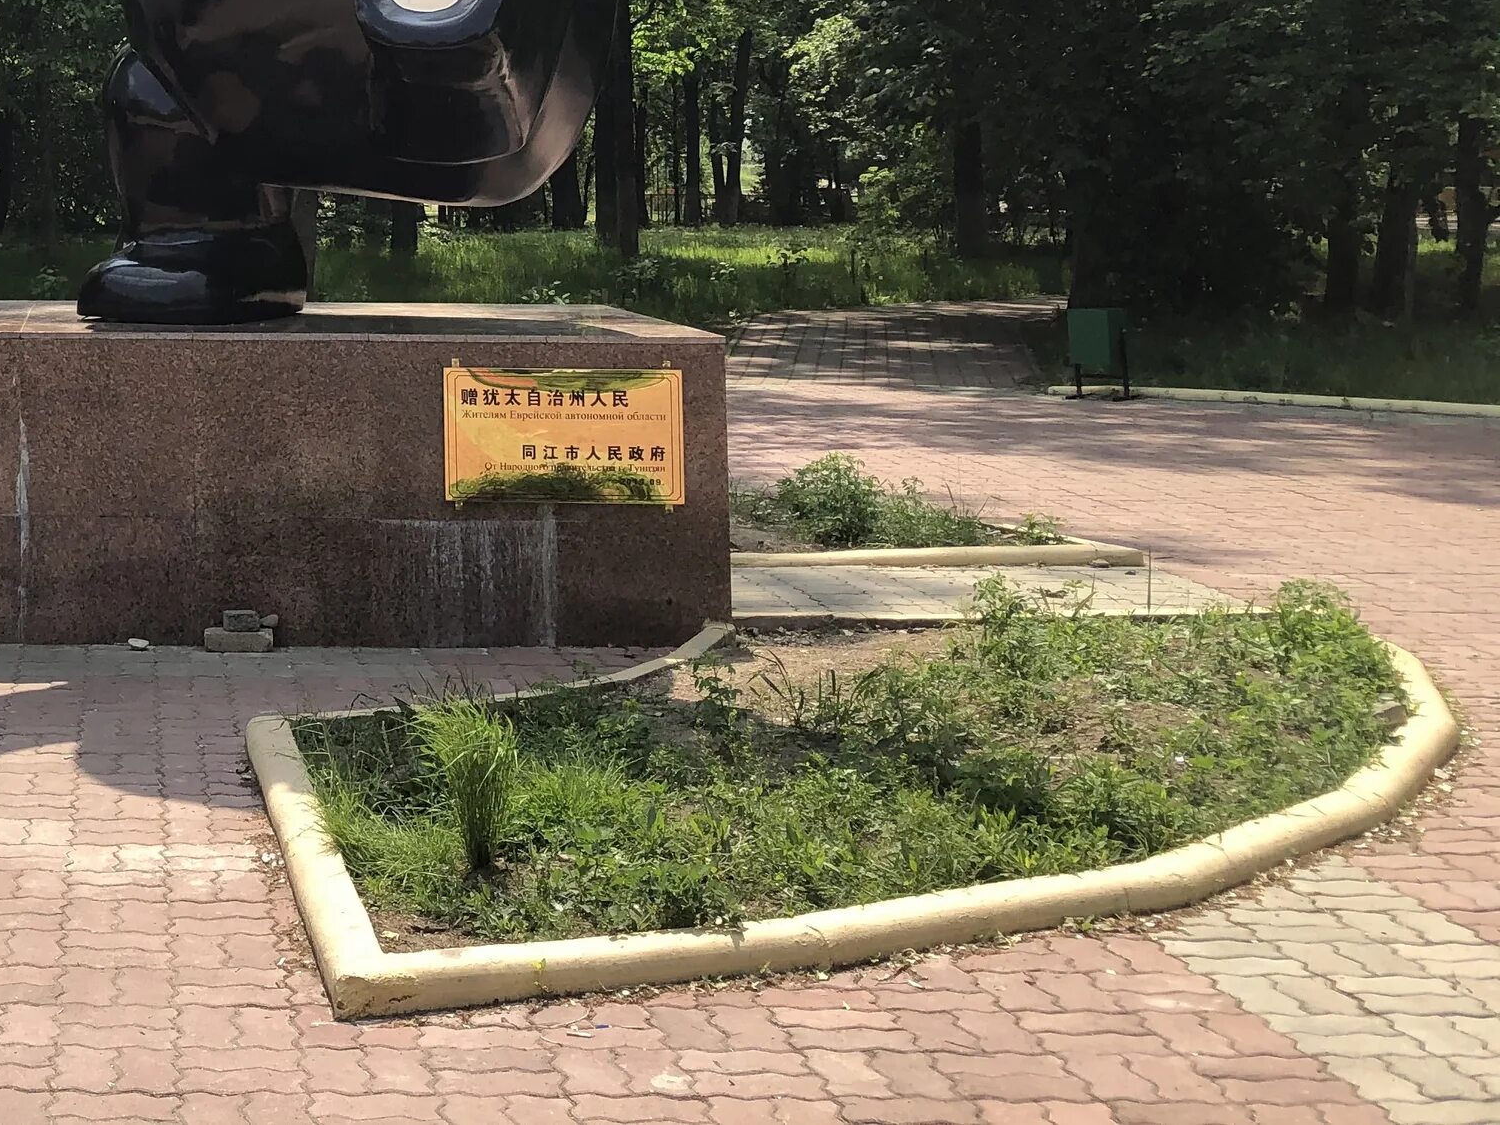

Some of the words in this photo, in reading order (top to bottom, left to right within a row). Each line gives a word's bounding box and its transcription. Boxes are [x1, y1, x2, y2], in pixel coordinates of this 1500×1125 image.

[460, 388, 629, 408] 赠犹太自治州人民
[461, 409, 507, 420] Жителям
[509, 409, 563, 422] Еврейской
[564, 410, 625, 421] автономной
[626, 411, 667, 421] области
[522, 444, 666, 462] 同江市人民政府
[499, 462, 549, 474] Народного
